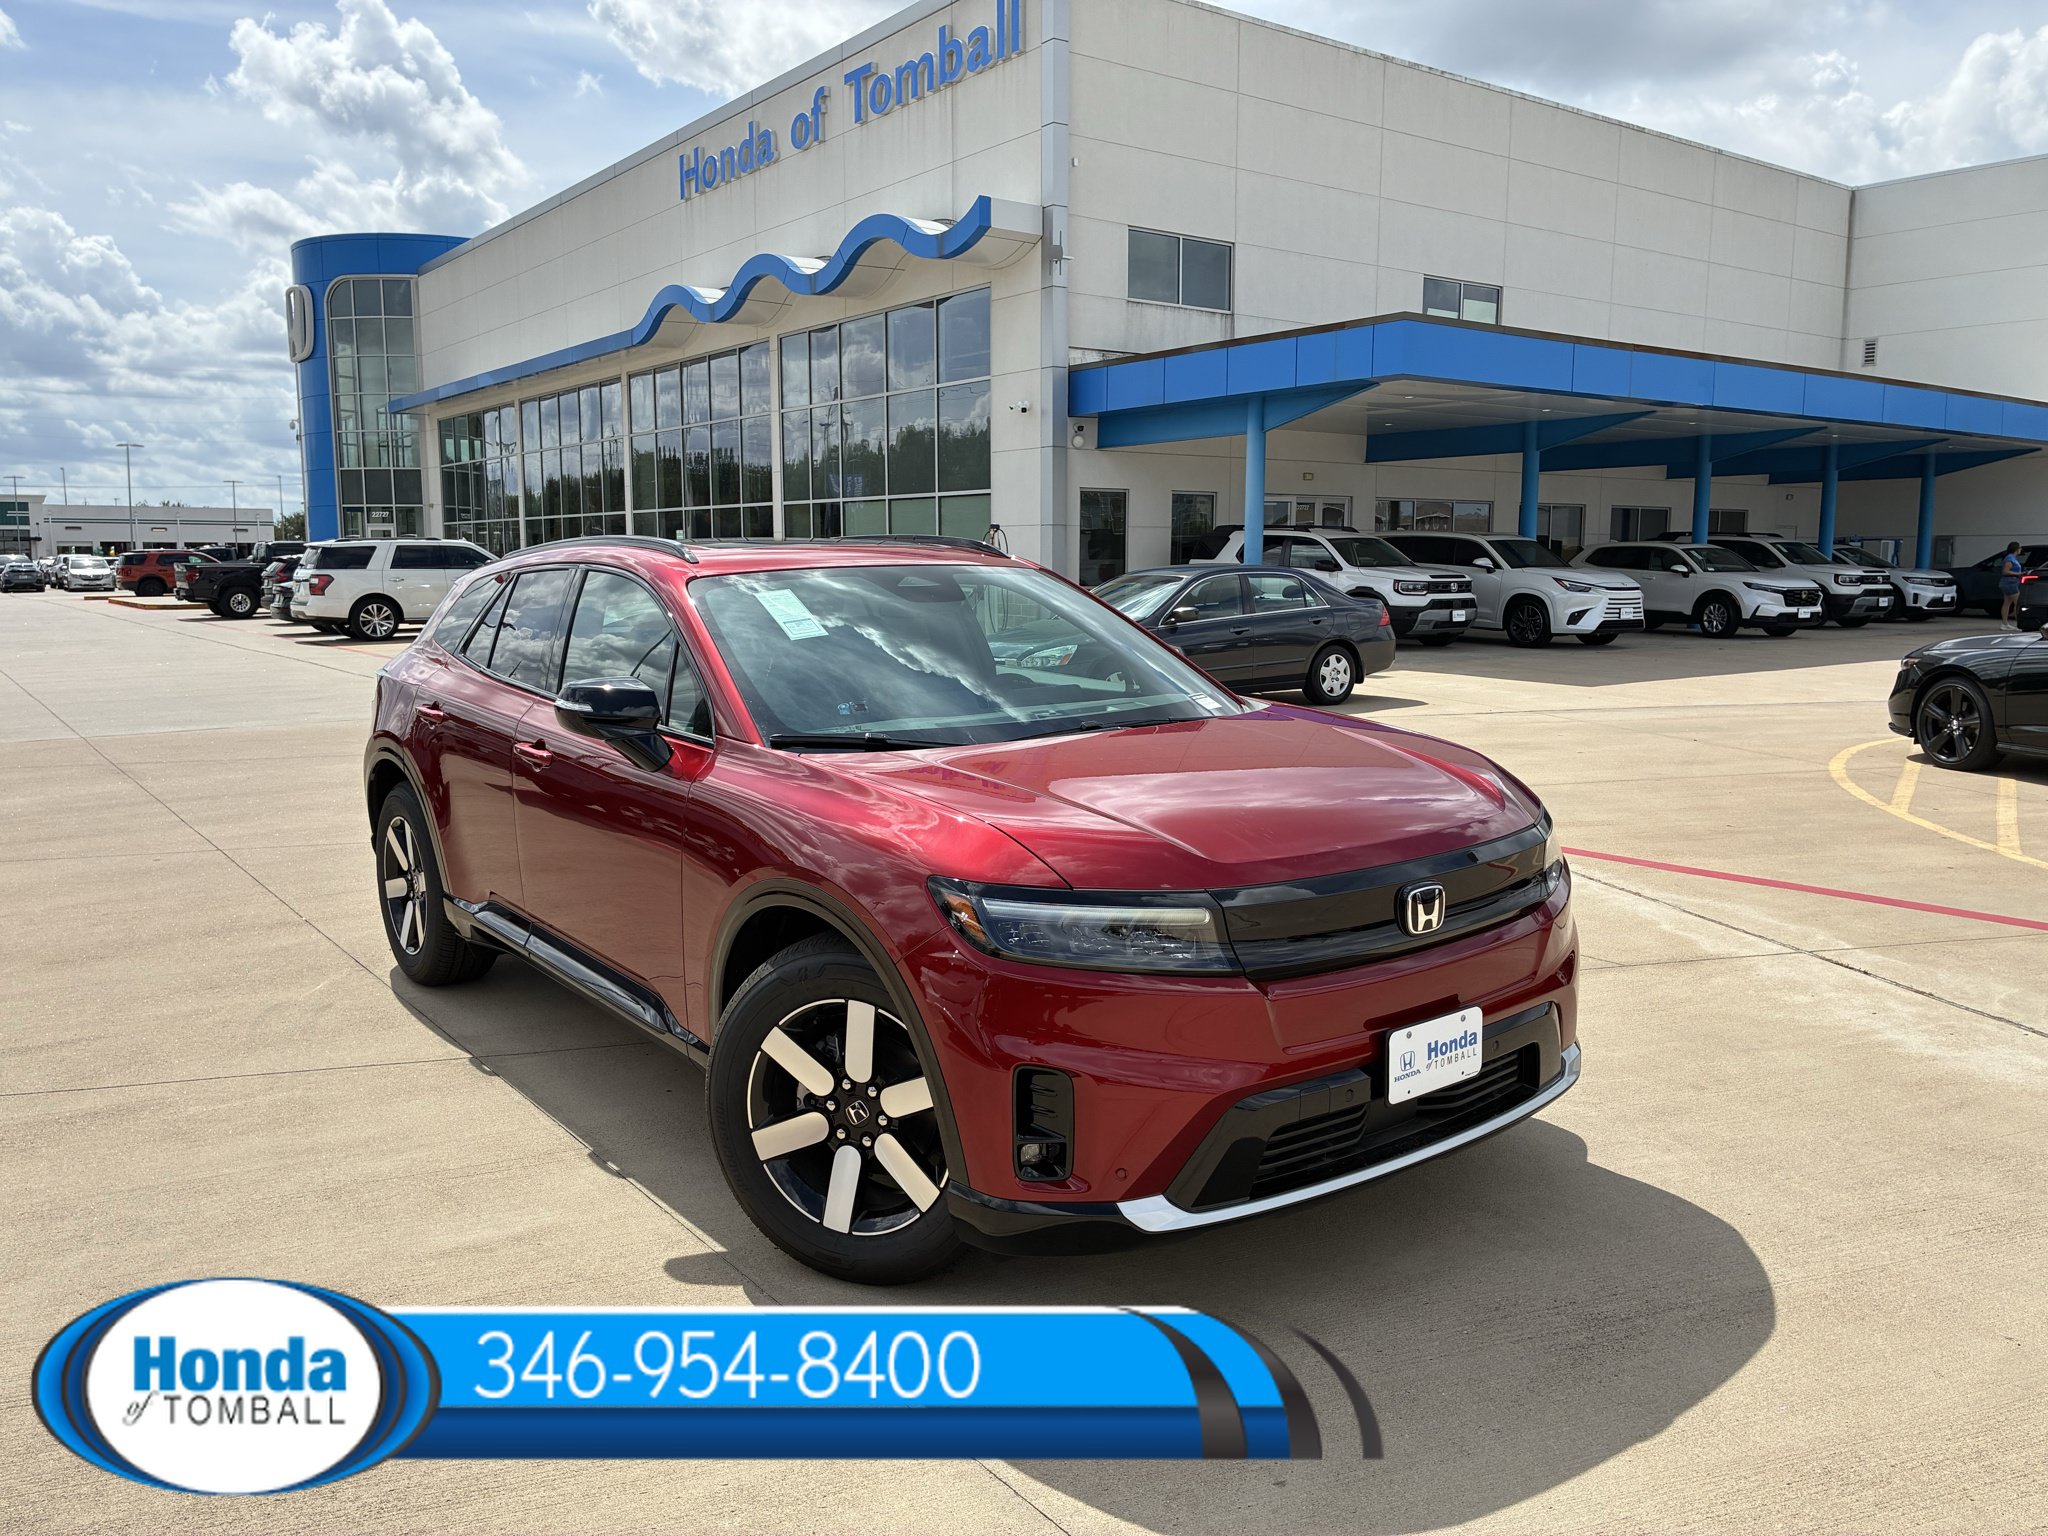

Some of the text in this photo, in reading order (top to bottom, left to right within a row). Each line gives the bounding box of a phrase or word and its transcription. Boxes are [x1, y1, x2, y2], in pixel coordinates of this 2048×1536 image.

[679, 0, 1025, 200] Honda of Tomball
[1427, 1030, 1477, 1060] Honda
[1434, 1048, 1477, 1069] TOMBALL
[1394, 1069, 1421, 1082] HONDA
